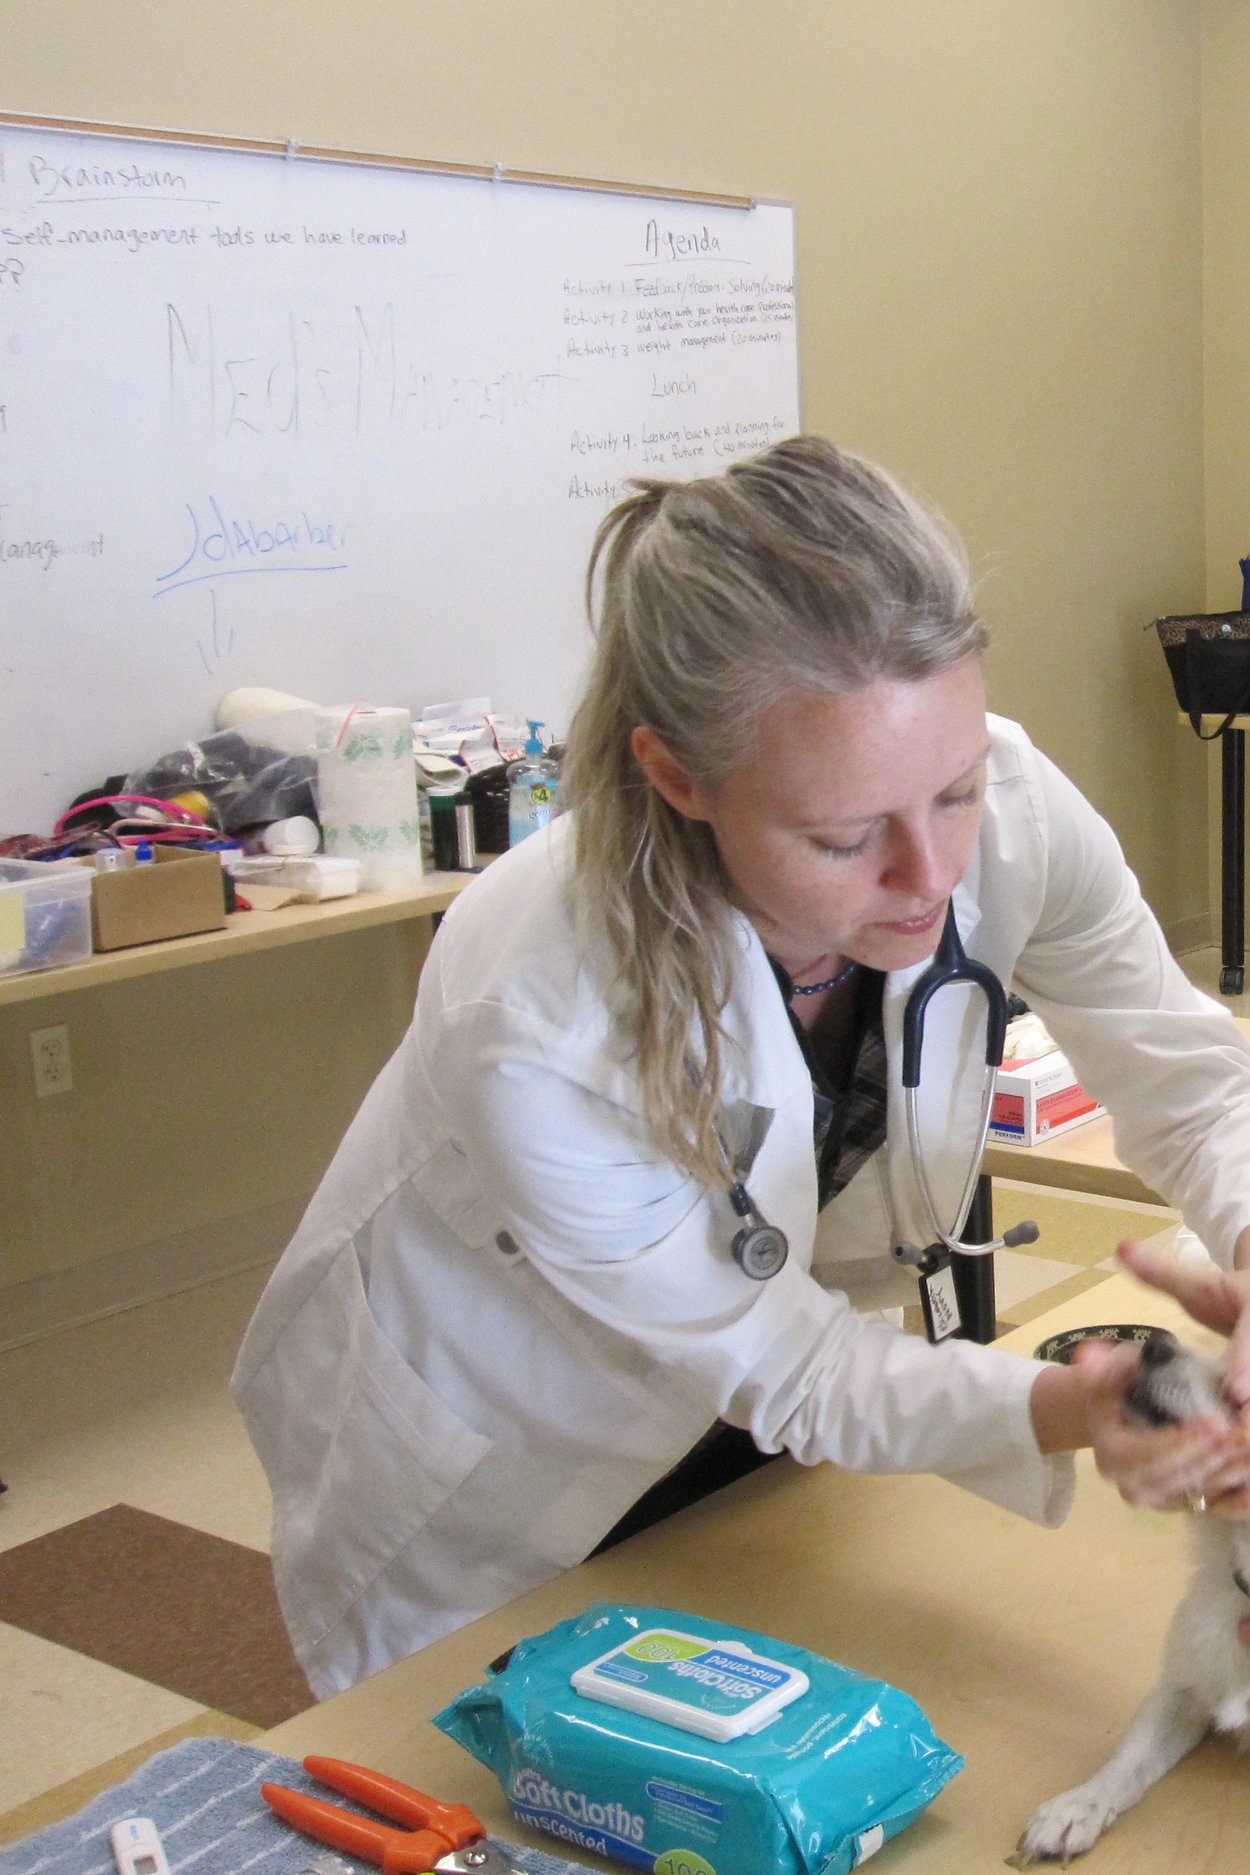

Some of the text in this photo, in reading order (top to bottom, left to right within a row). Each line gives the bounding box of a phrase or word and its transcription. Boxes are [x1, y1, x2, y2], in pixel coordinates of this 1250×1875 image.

[264, 233, 295, 244] we
[303, 225, 343, 245] have
[351, 227, 407, 246] learned
[645, 218, 721, 259] Agenda
[566, 337, 617, 358] Activity
[651, 374, 697, 396] Lunch
[570, 430, 618, 454] Activity
[642, 421, 681, 444] Looking
[684, 424, 711, 441] back
[568, 475, 617, 498] Activity
[703, 1655, 782, 1684] unscented
